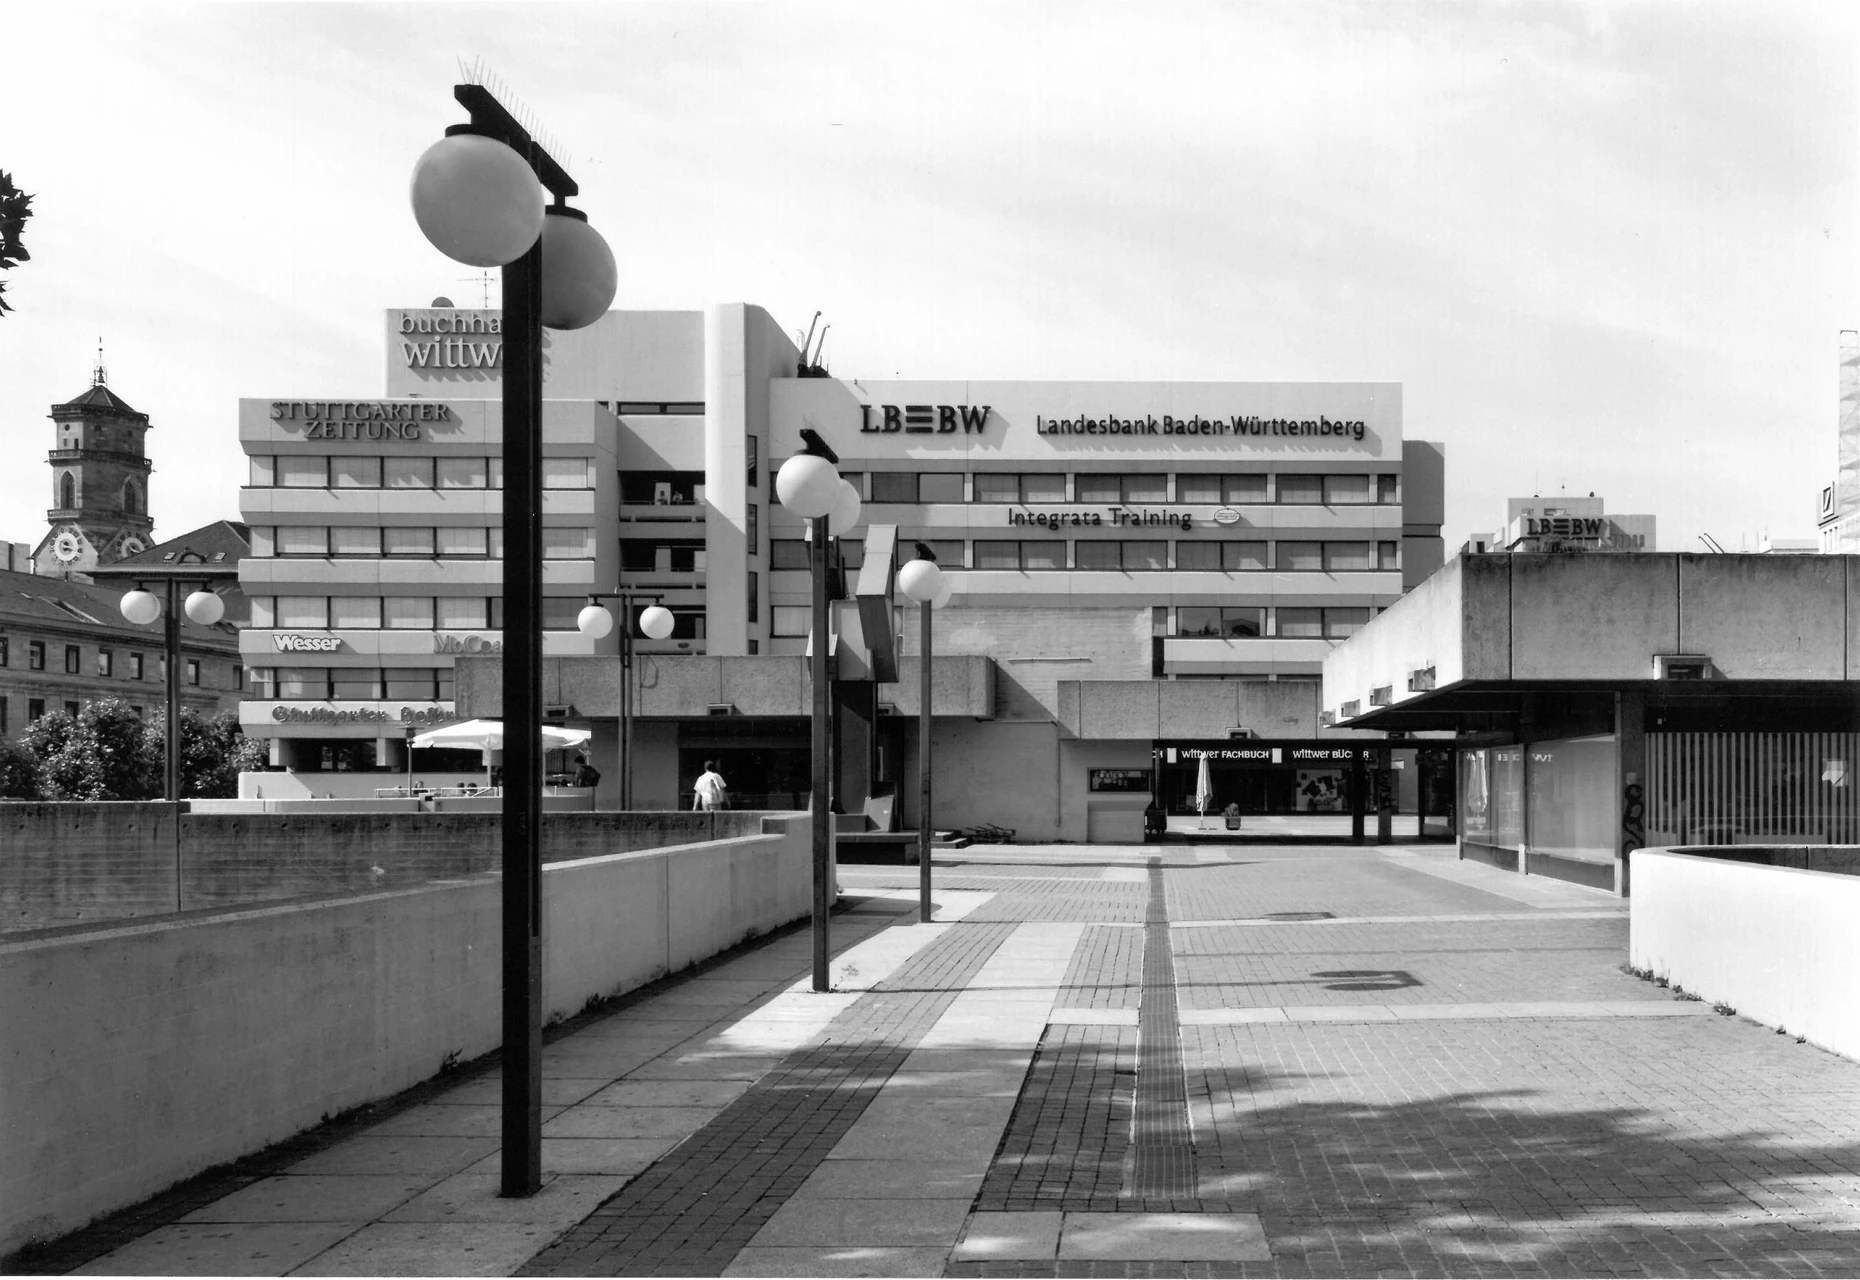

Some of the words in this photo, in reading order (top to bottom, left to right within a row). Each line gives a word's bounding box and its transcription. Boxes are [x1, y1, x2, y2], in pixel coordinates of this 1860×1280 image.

[400, 312, 502, 333] buchha
[401, 335, 502, 368] wittw
[270, 402, 449, 420] STUTTGARTER
[304, 421, 420, 440] ZEITUNG
[1037, 414, 1158, 435] Landesbank
[1163, 413, 1365, 440] Baden-Württemberg
[1009, 507, 1101, 530] Integrata
[1108, 507, 1192, 530] Training
[272, 634, 341, 652] Wesser
[1221, 750, 1269, 758] FACHBUCH
[1293, 748, 1330, 758] wittwer
[1331, 748, 1369, 758] BÜCR
